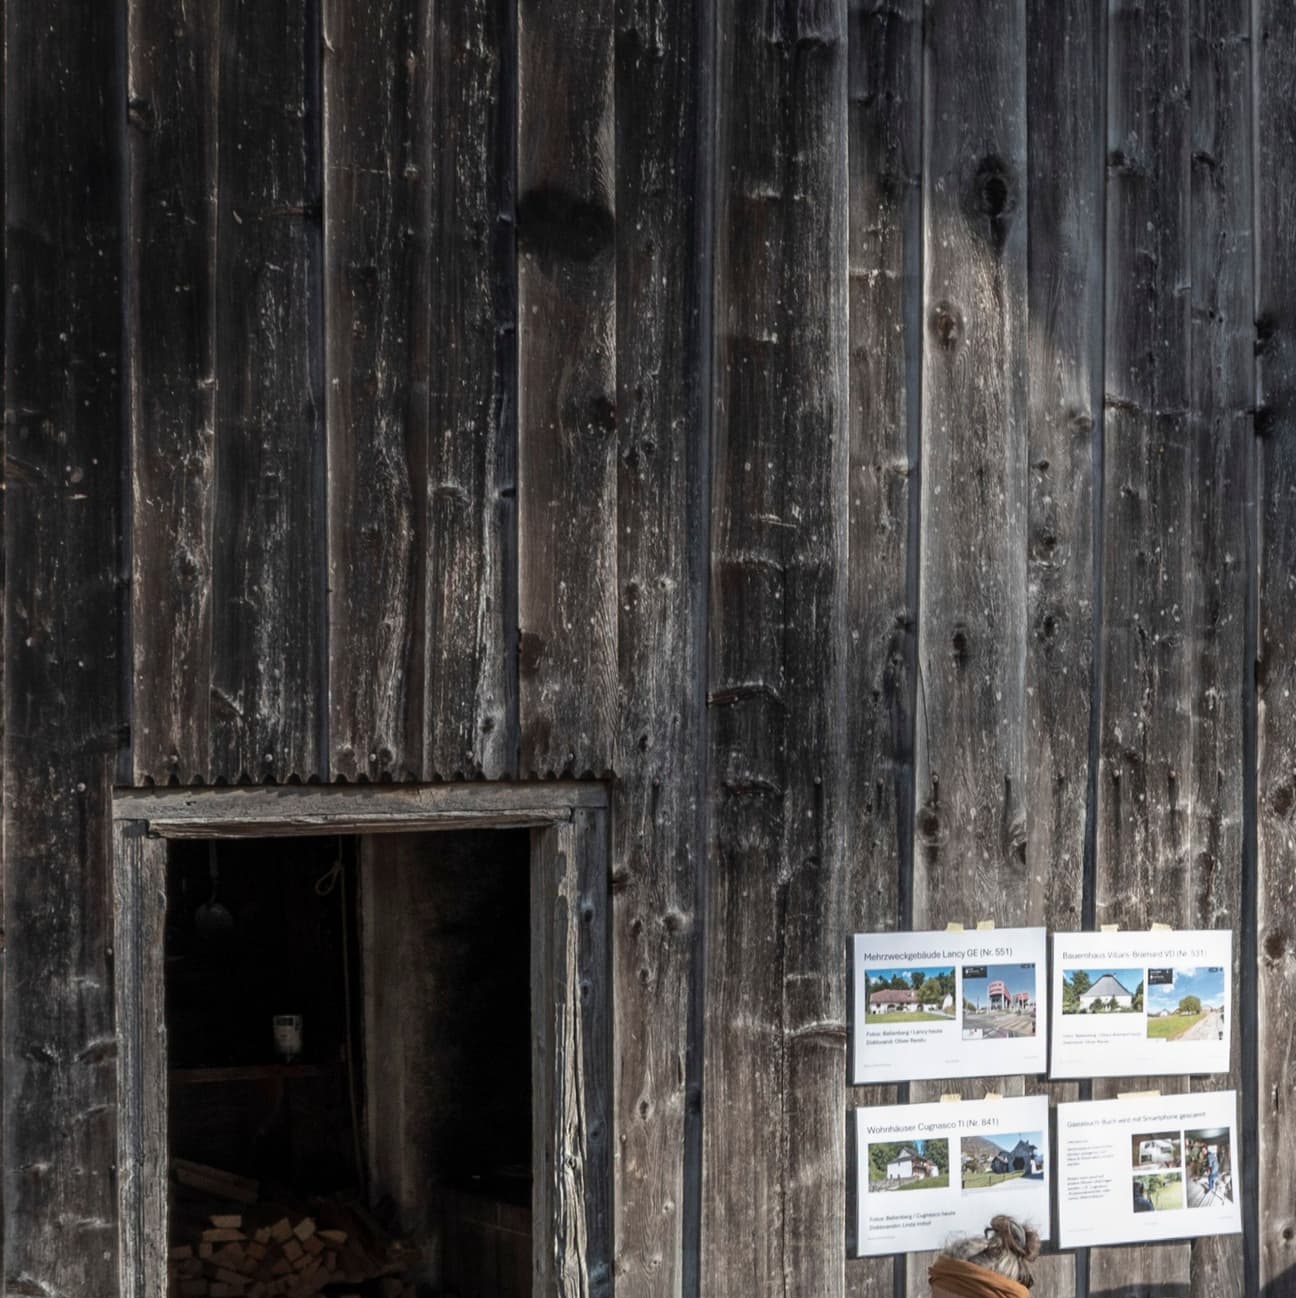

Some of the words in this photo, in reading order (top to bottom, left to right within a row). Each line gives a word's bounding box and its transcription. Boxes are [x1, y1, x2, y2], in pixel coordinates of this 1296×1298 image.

[864, 951, 942, 962] Mehrzweckgebäude
[942, 950, 965, 961] Lancy
[967, 949, 978, 958] GE
[995, 947, 1013, 958] 551)
[866, 1124, 916, 1135] Wohnhäuser
[917, 1121, 957, 1132] Cugnasco
